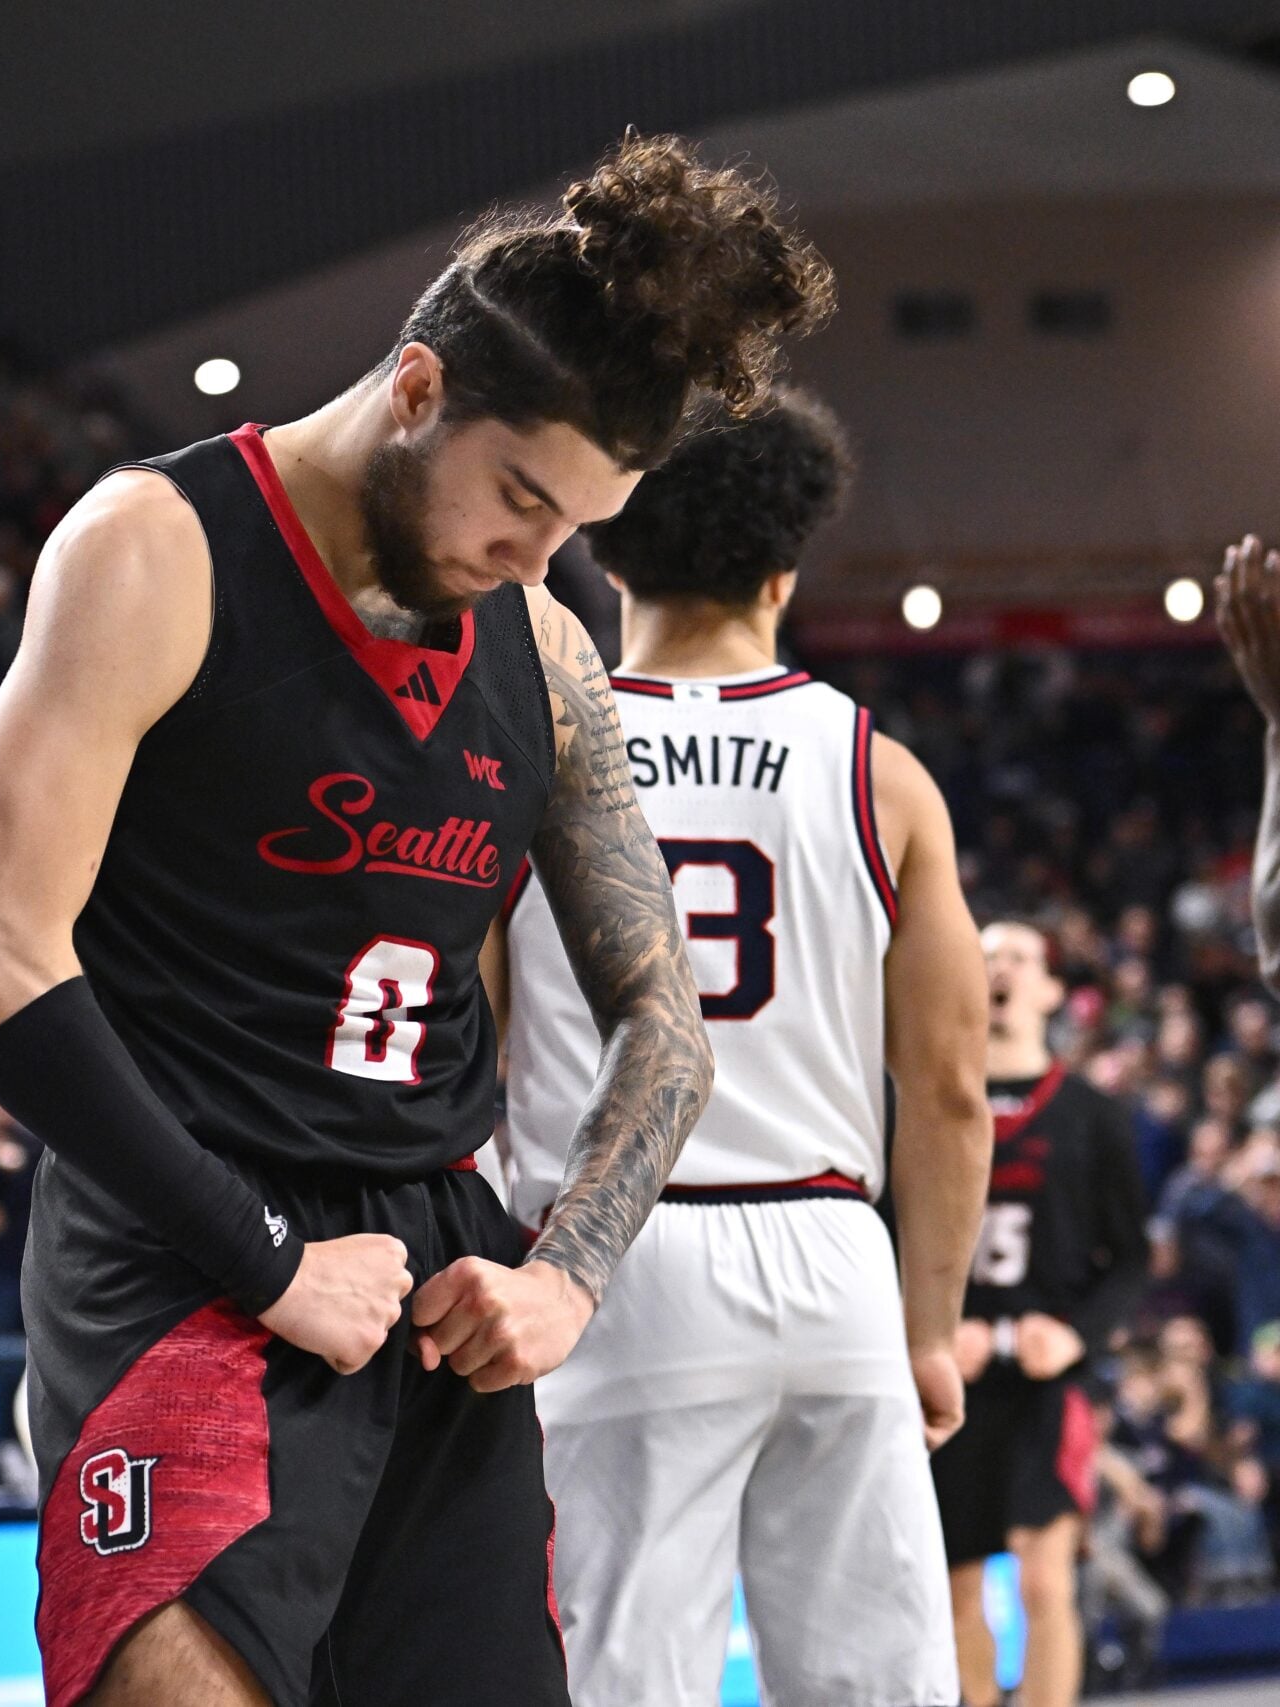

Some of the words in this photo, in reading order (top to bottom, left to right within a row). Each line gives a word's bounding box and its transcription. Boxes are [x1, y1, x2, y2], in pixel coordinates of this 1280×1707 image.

[257, 772, 500, 888] Seattle
[626, 735, 790, 793] SMITH
[657, 838, 775, 1020] 3
[324, 933, 441, 1086] 0
